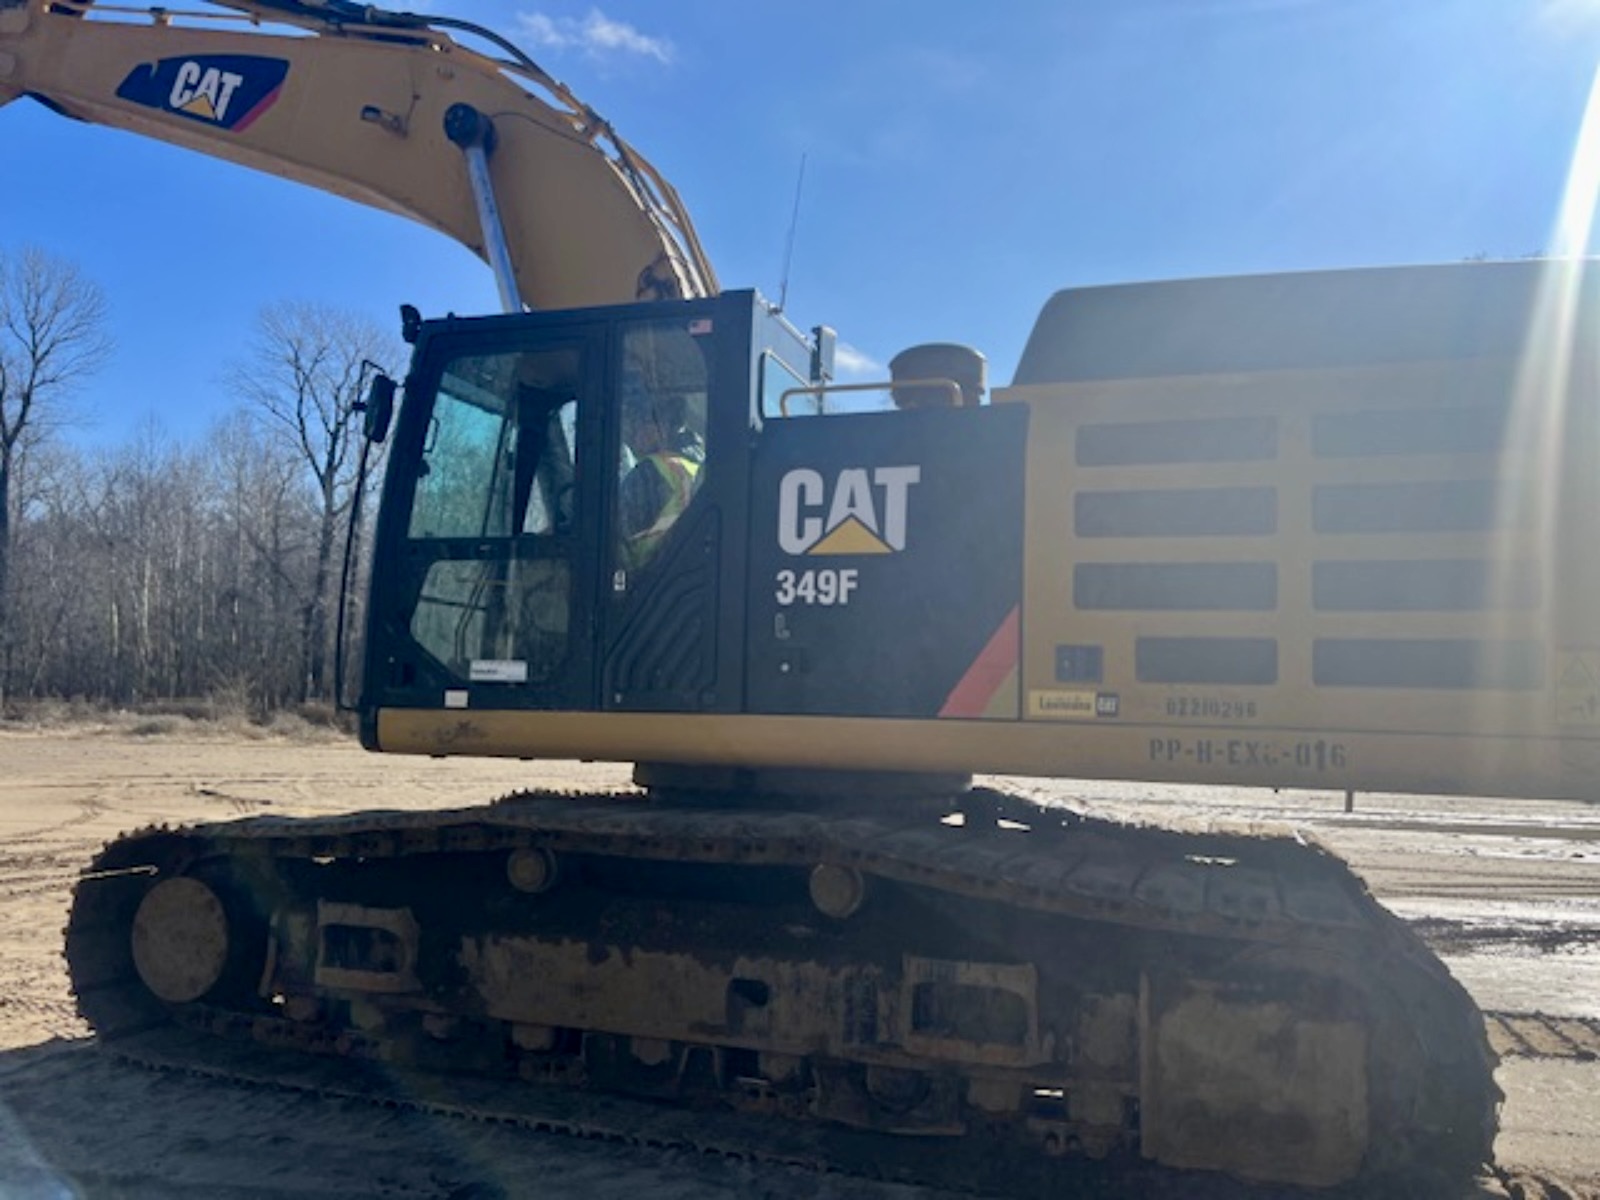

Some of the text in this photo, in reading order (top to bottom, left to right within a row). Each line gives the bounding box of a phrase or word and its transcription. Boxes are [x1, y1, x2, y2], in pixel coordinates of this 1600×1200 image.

[169, 60, 243, 121] CAT
[777, 465, 921, 556] CAT
[775, 569, 858, 606] 349F
